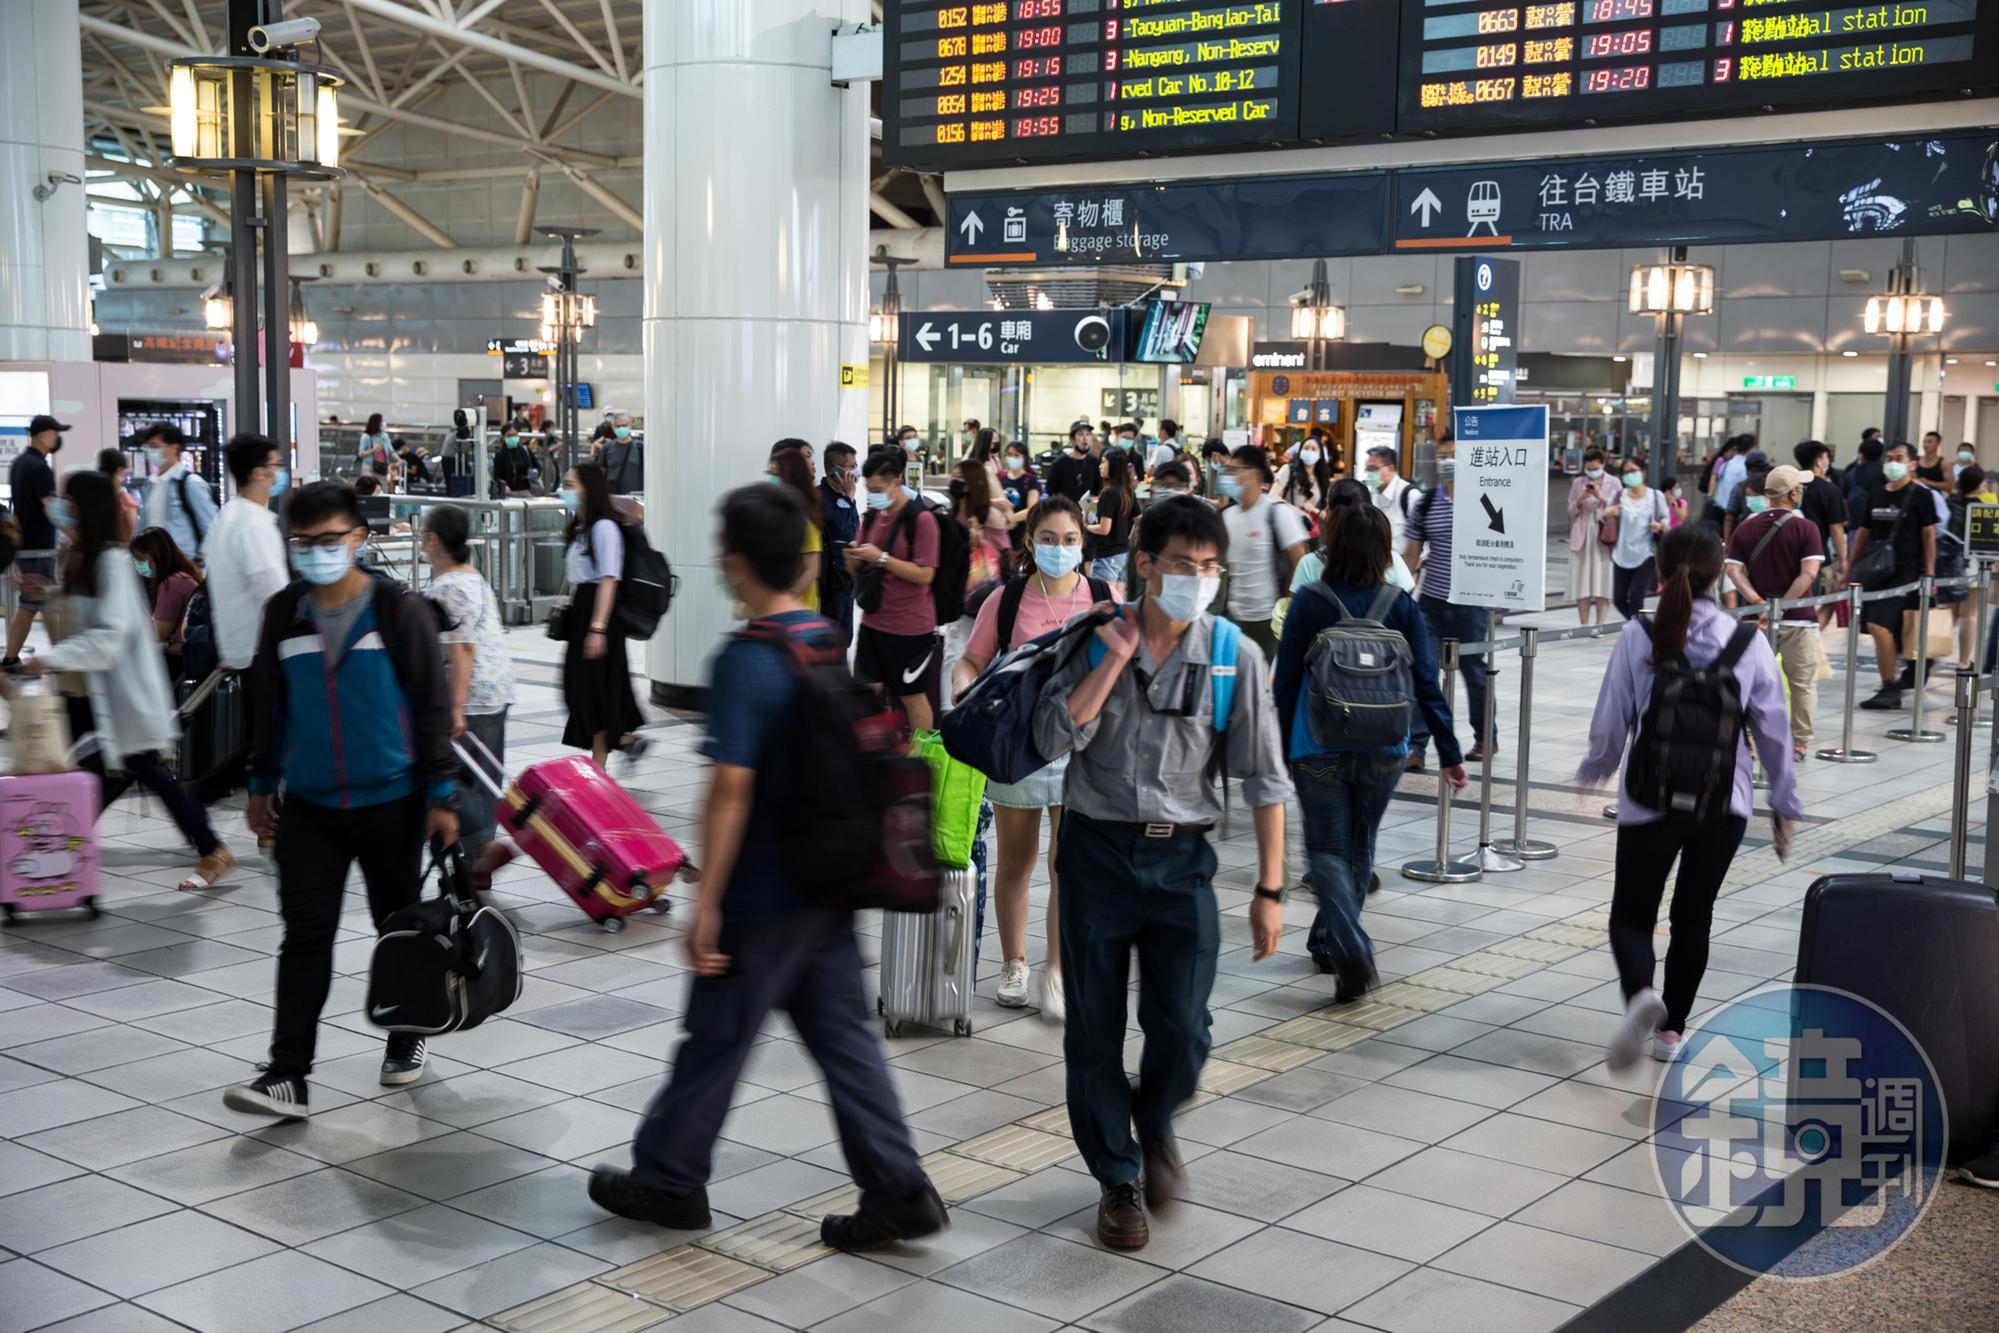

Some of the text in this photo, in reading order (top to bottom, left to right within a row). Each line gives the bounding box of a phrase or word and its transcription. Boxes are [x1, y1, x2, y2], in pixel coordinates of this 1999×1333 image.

[938, 7, 967, 29] 0152
[1019, 0, 1061, 18] 18:55
[1478, 8, 1518, 33] 0663
[1592, 0, 1652, 20] 18:45
[938, 36, 967, 57] 0678
[1018, 27, 1062, 49] 19:00
[1106, 20, 1118, 40] 3
[1477, 43, 1517, 68] 0149
[1590, 31, 1651, 56] 19:05
[1725, 23, 1733, 43] 1
[1842, 5, 1927, 32] station
[939, 65, 967, 86] 1254
[1017, 57, 1061, 78] 19:15
[1106, 51, 1117, 70] 3
[1197, 39, 1280, 62] Non-Reserv
[1475, 77, 1515, 101] 0667
[1588, 67, 1649, 91] 19:20
[1715, 59, 1730, 81] 3
[1840, 43, 1924, 70] station
[1017, 86, 1060, 108] 19:25
[1110, 83, 1116, 99] 1
[1121, 79, 1152, 99] rved
[1158, 77, 1183, 96] Car
[1188, 69, 1255, 94] No.10-12
[937, 123, 965, 144] 0156
[1016, 116, 1060, 137] 19:55
[1110, 113, 1116, 129] 1
[1142, 102, 1237, 128] Non-Reserved
[1243, 100, 1270, 121] Car
[1538, 165, 1706, 207] 往台鐵車站
[1053, 199, 1124, 228] 寄物櫃
[1539, 212, 1573, 232] TRA
[1116, 233, 1169, 250] storage
[947, 322, 993, 350] 1-6
[1000, 320, 1032, 340] 車廂
[1000, 341, 1019, 354] Car
[520, 357, 529, 376] 3
[1125, 391, 1138, 412] 3
[1470, 446, 1527, 468] 進站入口
[1480, 476, 1511, 487] Entrance
